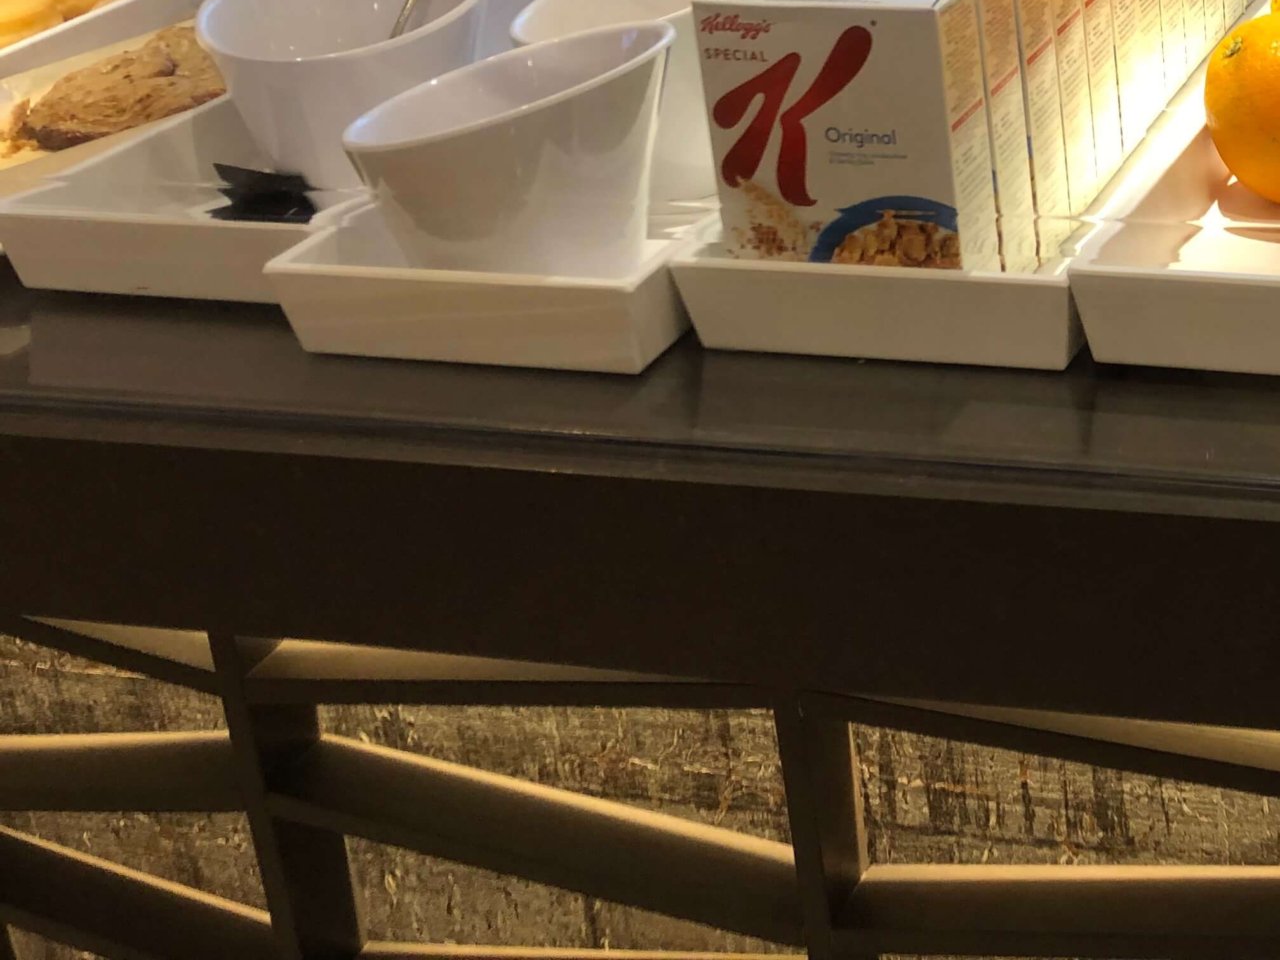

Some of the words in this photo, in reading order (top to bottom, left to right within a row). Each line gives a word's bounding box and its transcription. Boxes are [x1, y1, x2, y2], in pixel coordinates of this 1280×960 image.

[701, 13, 772, 39] Kellogg's
[704, 48, 768, 62] SPECIAL
[713, 25, 873, 207] K
[825, 127, 897, 148] Original
